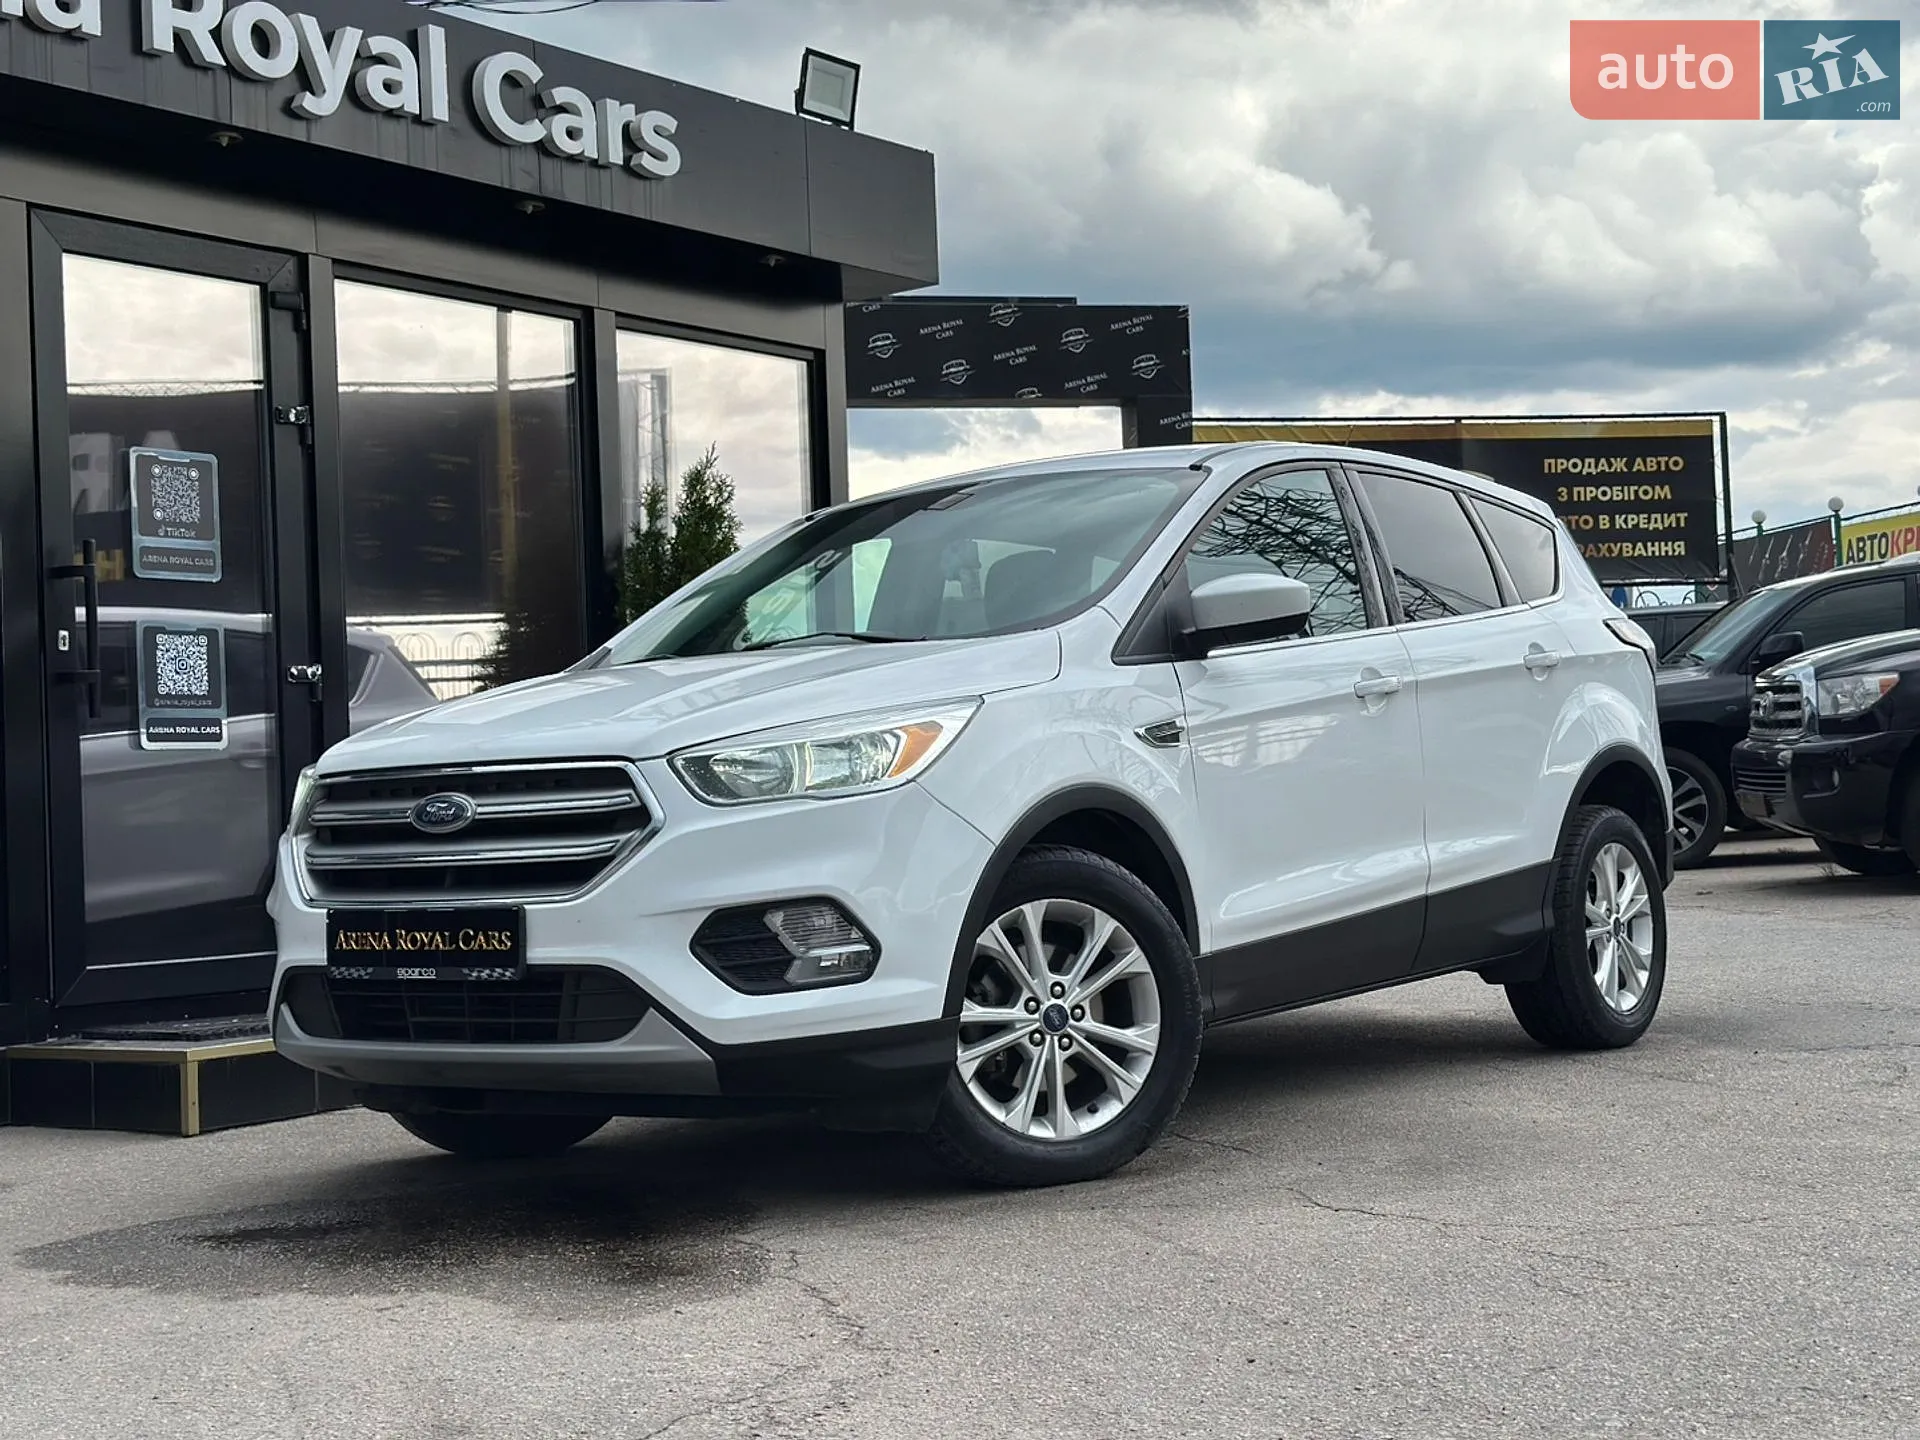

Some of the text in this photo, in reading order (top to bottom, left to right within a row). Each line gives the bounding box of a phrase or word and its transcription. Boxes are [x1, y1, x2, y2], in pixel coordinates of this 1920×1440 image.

[140, 0, 450, 124] Royal
[472, 51, 682, 180] Cars
[1543, 455, 1685, 475] ПРОДАЖ АВТО
[1573, 484, 1672, 502] ПРОБІГОМ
[1599, 514, 1611, 530] В
[1614, 511, 1688, 531] КРЕДИТ
[167, 526, 197, 538] TikTok
[201, 726, 220, 734] CARS
[334, 929, 512, 951] ARENA ROYAL CARS
[397, 967, 436, 980] sparco
